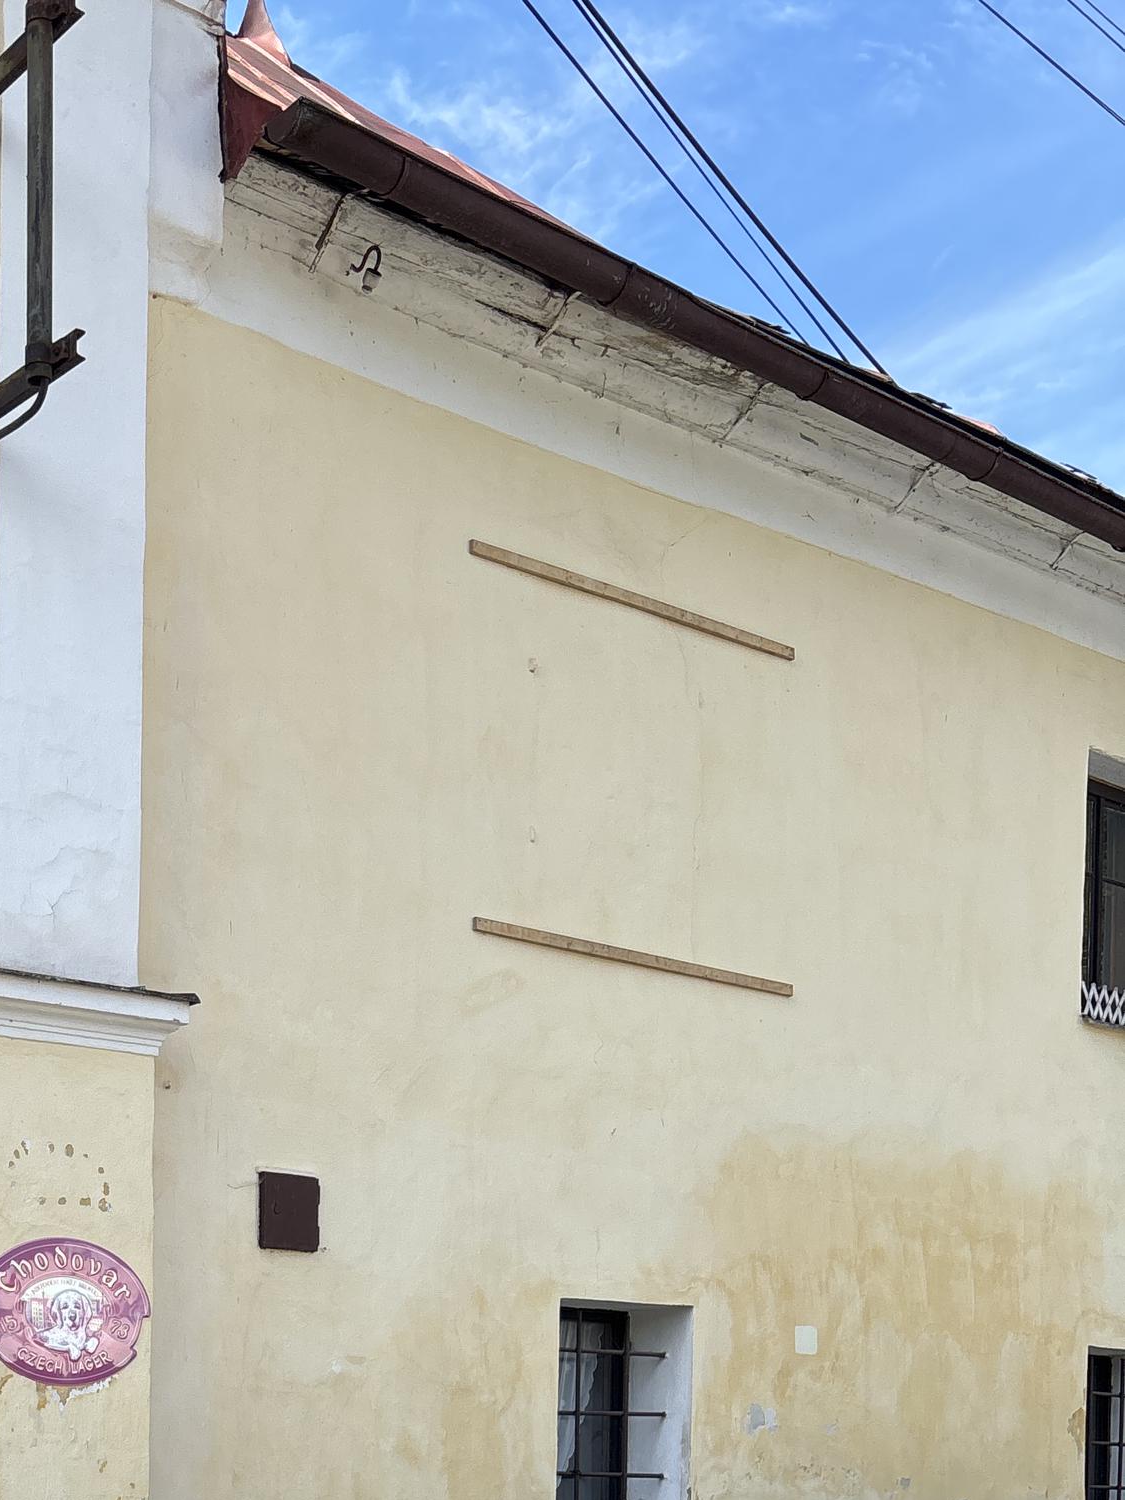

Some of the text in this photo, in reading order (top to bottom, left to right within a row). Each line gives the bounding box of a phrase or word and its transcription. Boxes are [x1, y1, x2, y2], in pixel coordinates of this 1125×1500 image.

[110, 1319, 130, 1339] 73
[17, 1348, 113, 1374] CZECH LAGER
